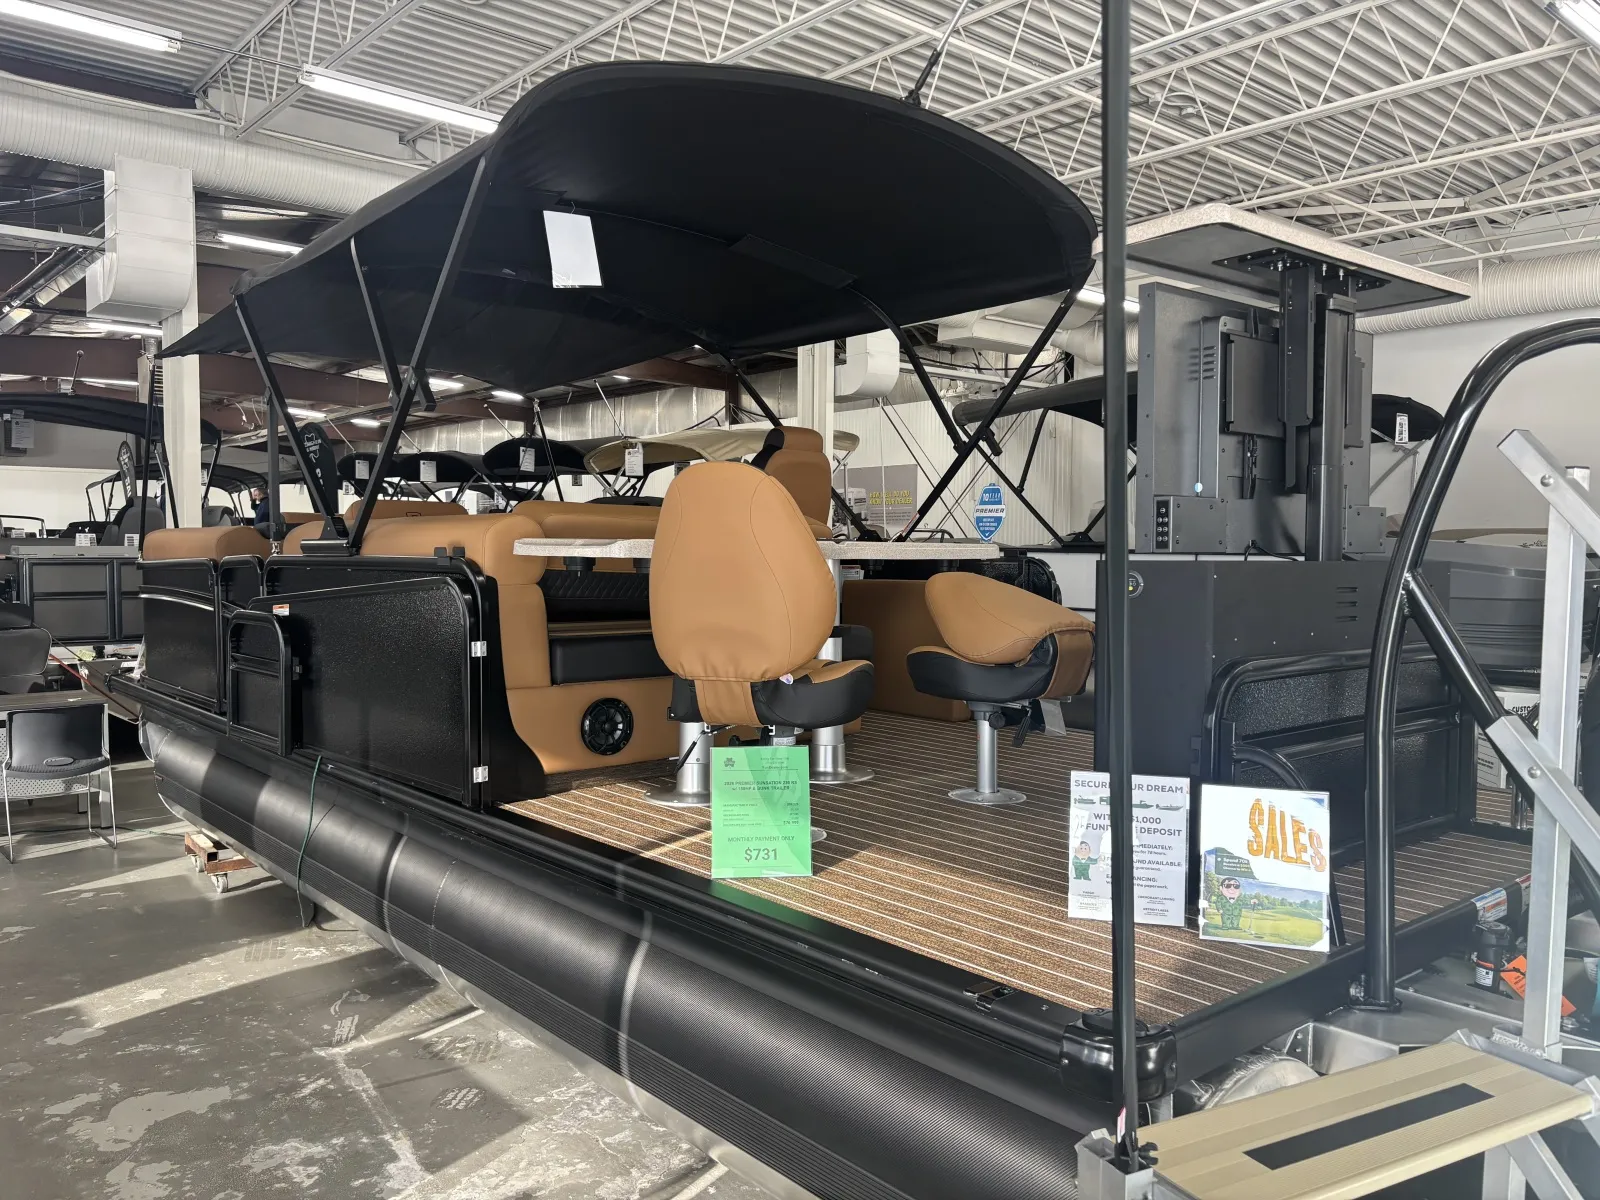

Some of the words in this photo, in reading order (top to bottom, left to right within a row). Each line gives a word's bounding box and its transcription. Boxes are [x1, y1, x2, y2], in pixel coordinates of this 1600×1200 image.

[1146, 784, 1184, 794] DREAM
[1140, 826, 1182, 836] DEPOSIT
[1247, 798, 1327, 872] SALES
[744, 846, 778, 862] $731
